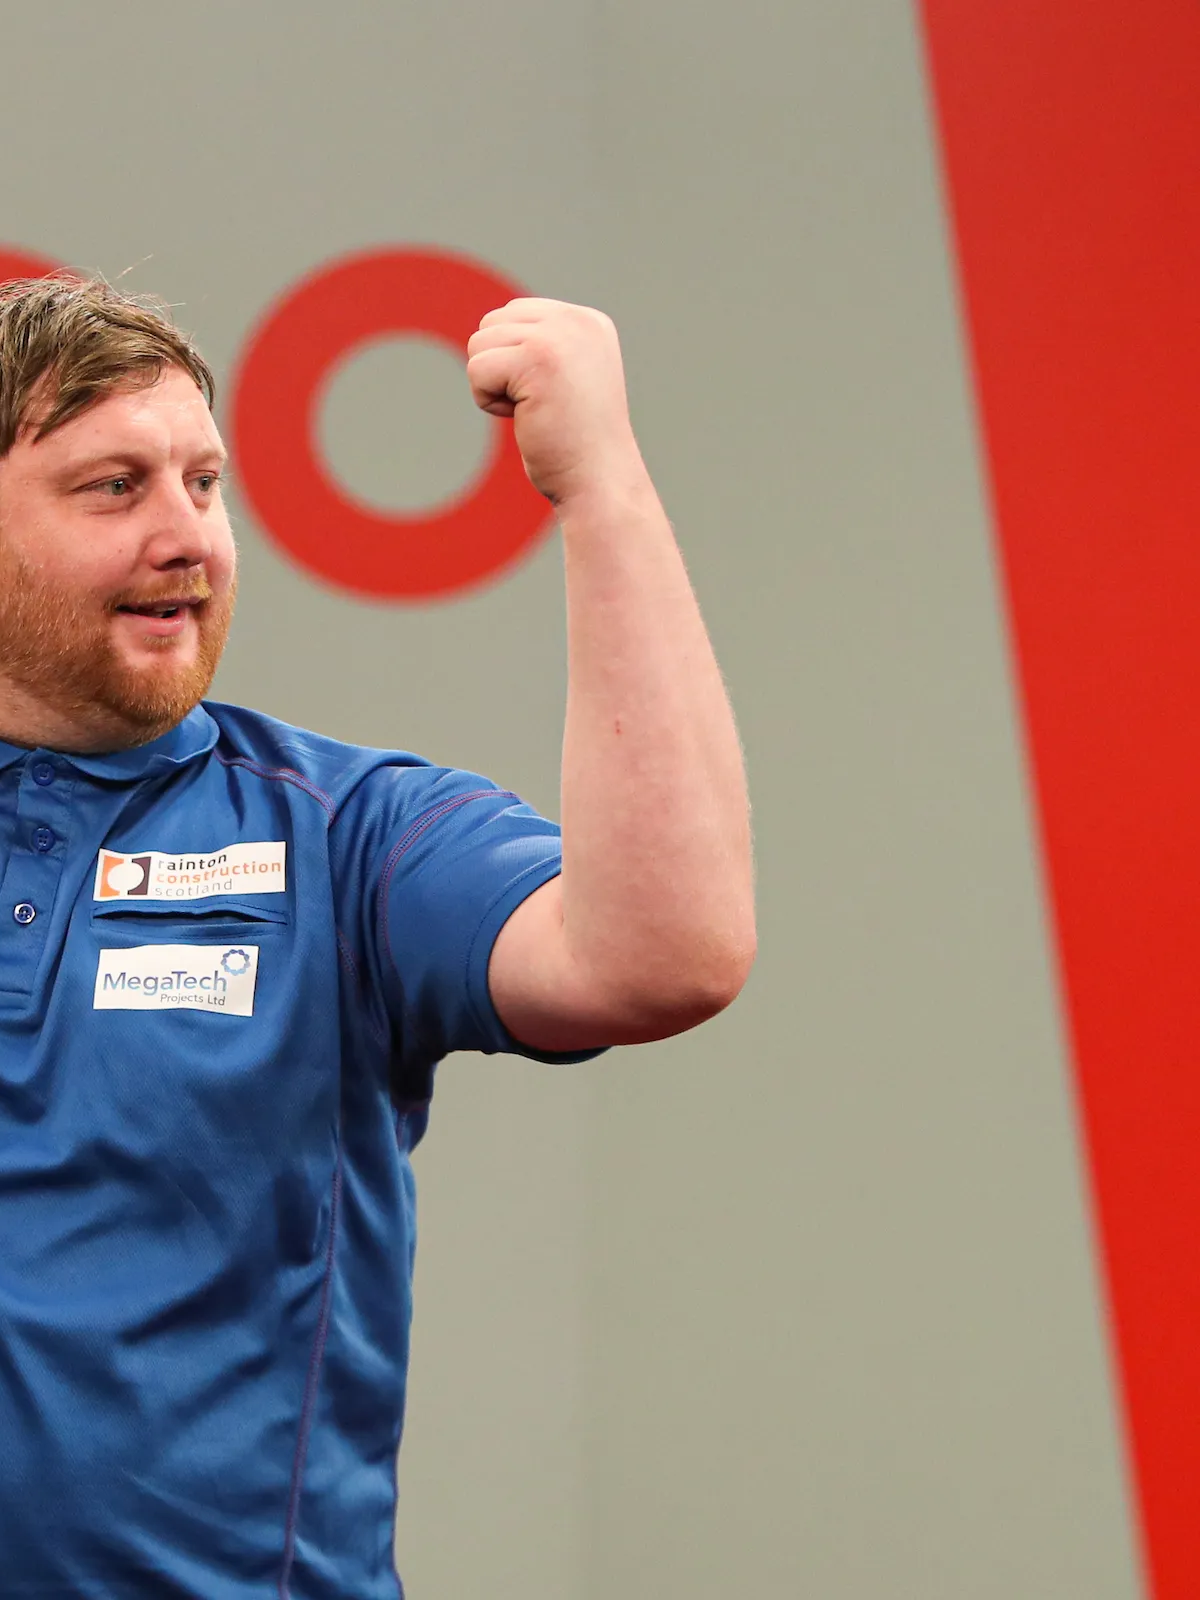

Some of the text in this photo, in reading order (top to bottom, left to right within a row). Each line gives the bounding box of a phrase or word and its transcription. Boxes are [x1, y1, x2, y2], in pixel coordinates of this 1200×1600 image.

[158, 854, 227, 871] rainton
[156, 861, 281, 884] construction
[155, 879, 232, 897] scotland
[103, 970, 227, 996] MegaTech
[160, 993, 225, 1006] Projects Ltd
